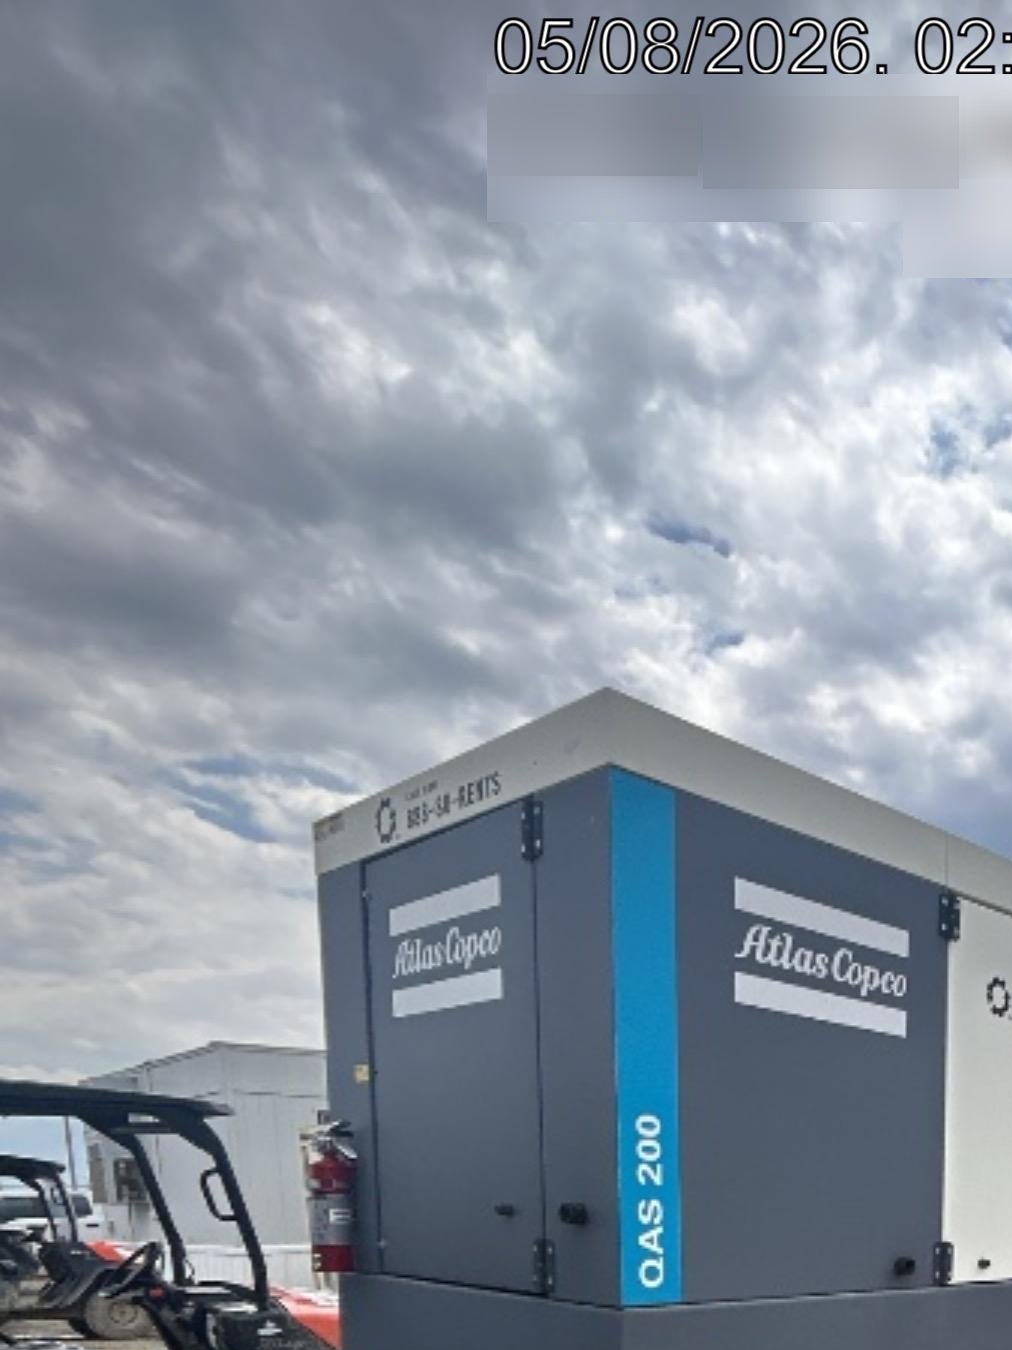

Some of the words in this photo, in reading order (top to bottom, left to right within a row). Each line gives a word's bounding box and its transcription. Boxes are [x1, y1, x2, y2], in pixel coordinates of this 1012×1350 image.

[392, 938, 444, 979] Atlas
[446, 926, 502, 970] Copco
[734, 924, 829, 979] Atlas
[831, 947, 907, 997] Copco
[635, 1114, 663, 1187] 200
[638, 1199, 664, 1288] QAS
